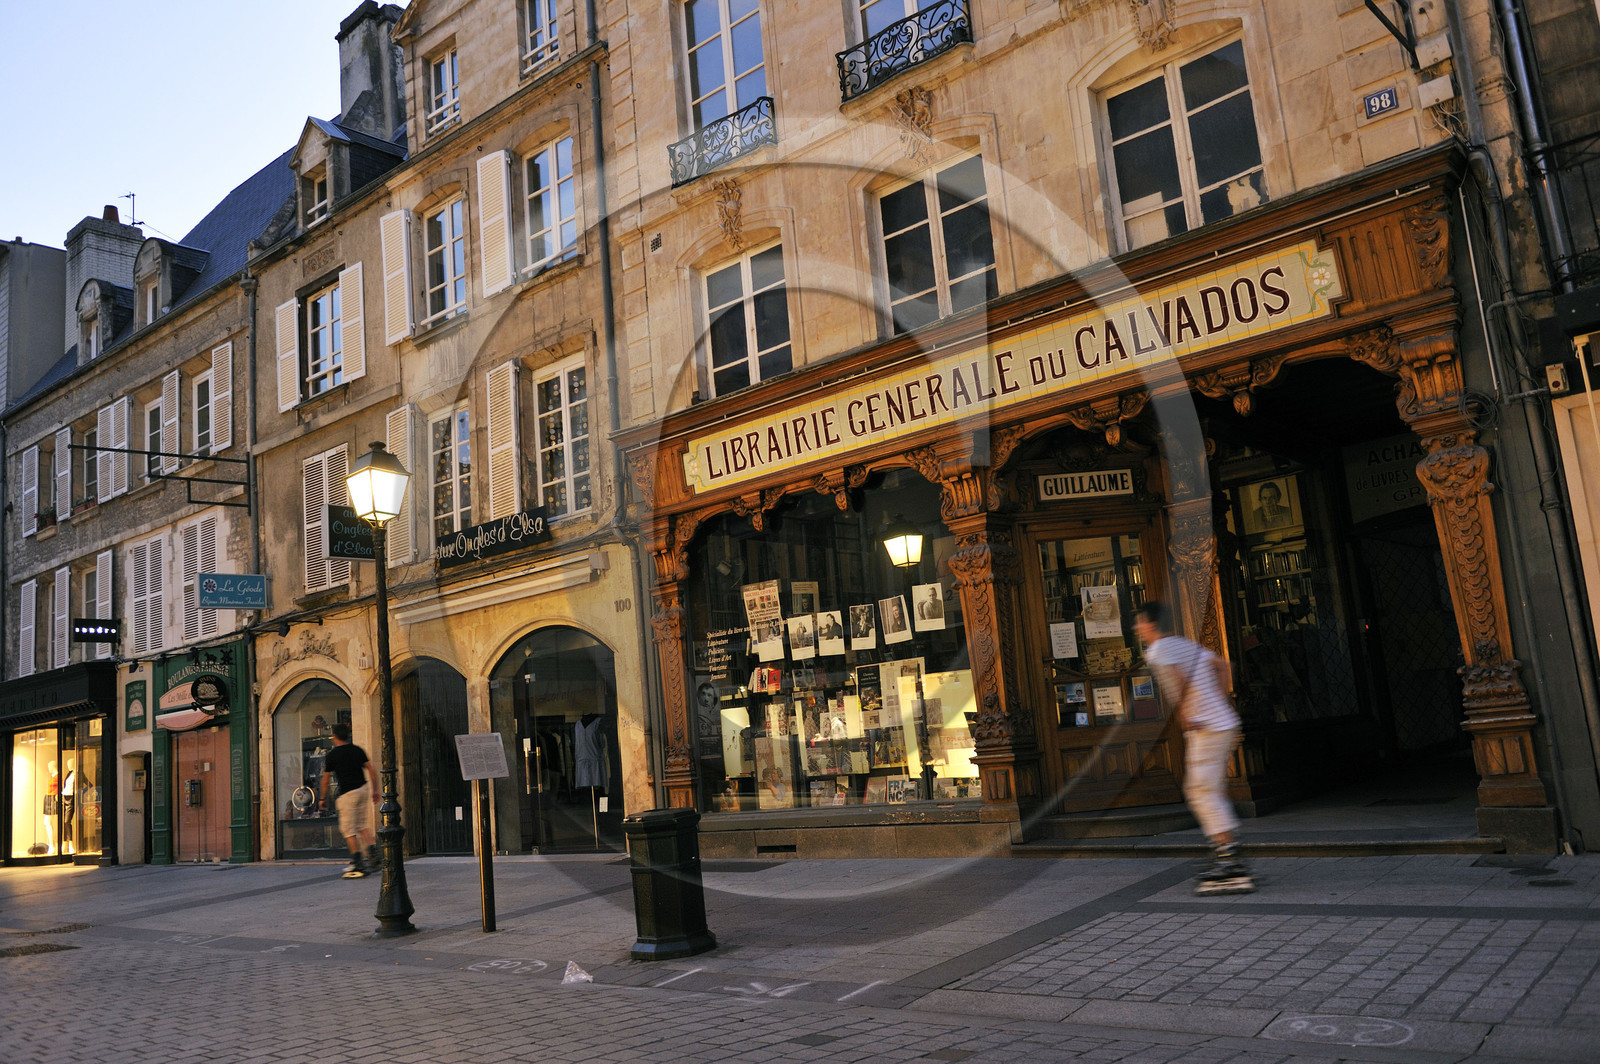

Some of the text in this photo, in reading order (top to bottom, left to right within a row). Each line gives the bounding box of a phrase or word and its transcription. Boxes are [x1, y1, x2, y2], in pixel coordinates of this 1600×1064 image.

[1370, 92, 1391, 112] 98
[705, 266, 1291, 481] LIBRAIRIE GENERALE DU CALVADOS
[1367, 441, 1424, 466] ACHA
[1043, 472, 1130, 496] GUILLAUME
[1371, 468, 1409, 488] LIVRES
[1392, 486, 1423, 502] GR
[342, 509, 357, 519] au
[332, 520, 374, 538] Ongles
[455, 525, 497, 560] Ongles
[497, 511, 544, 543] d'Elsa
[333, 541, 373, 555] d'Elsa
[1073, 550, 1106, 562] Littérature
[217, 579, 264, 596] La Géode
[613, 598, 632, 613] 100
[74, 625, 117, 635] sandro
